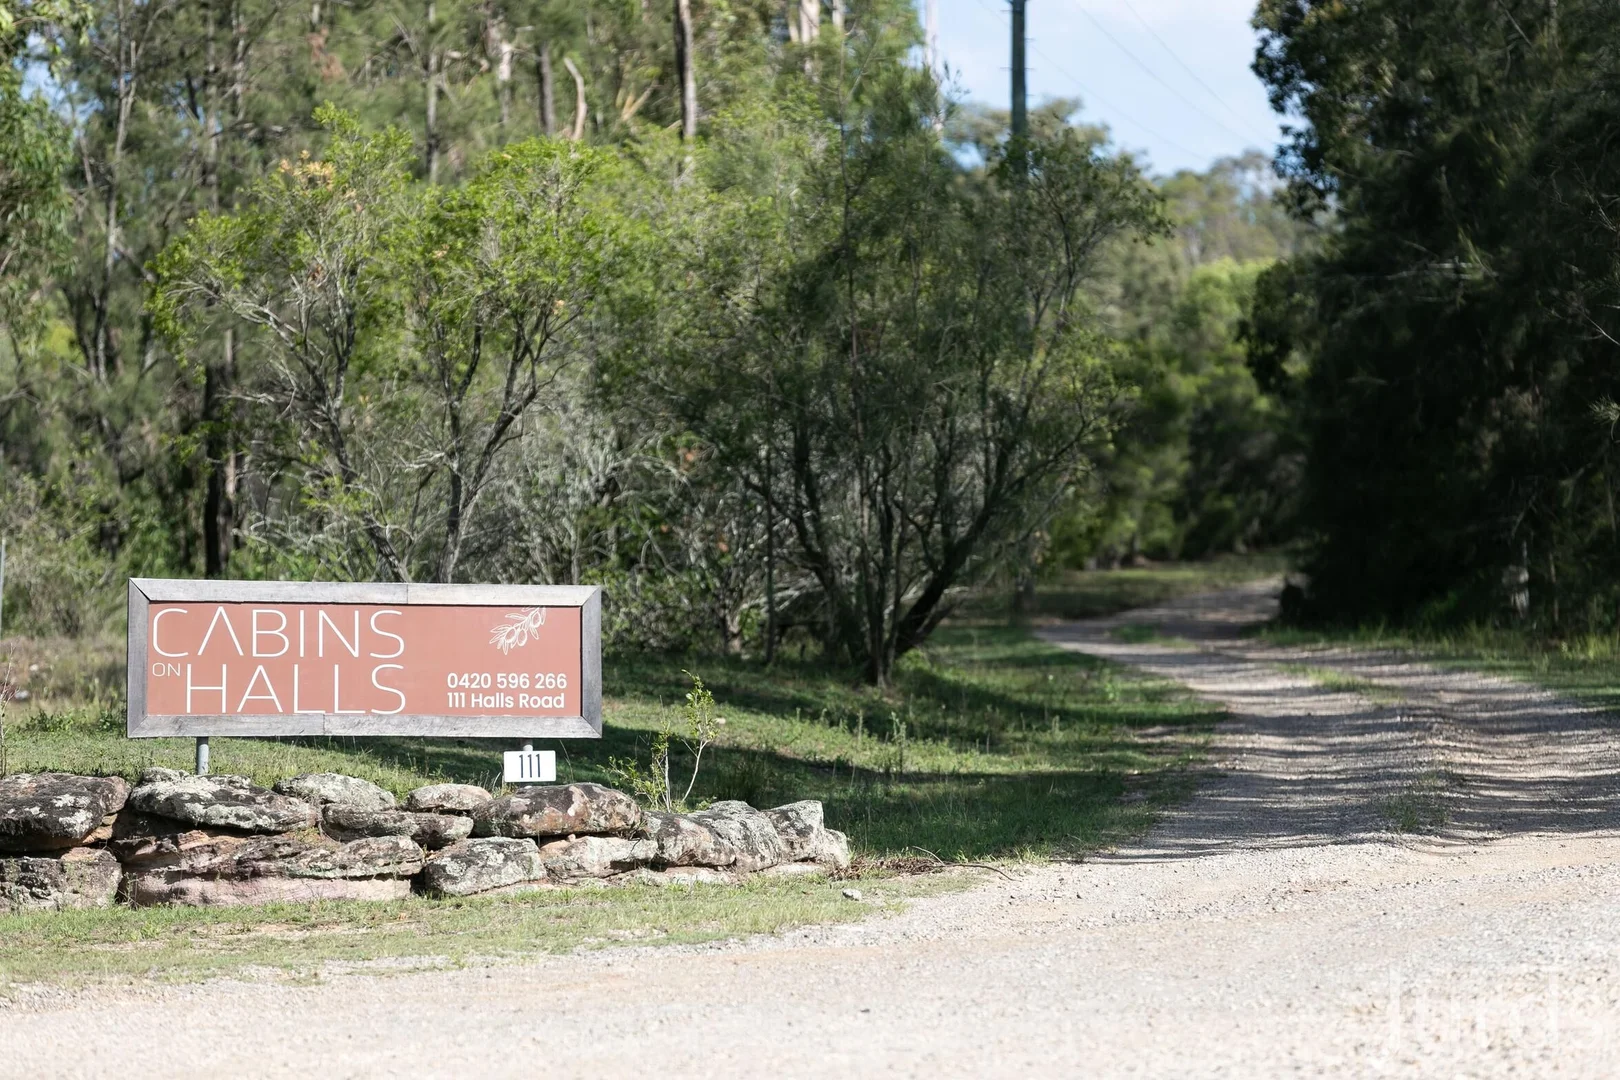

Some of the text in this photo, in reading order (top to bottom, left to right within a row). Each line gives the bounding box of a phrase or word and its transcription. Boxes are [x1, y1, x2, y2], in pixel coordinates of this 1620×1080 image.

[153, 606, 404, 658] CABINS
[153, 663, 405, 714] ON HALLS
[448, 673, 567, 688] 0420 596 266
[448, 693, 564, 708] 111 Halls Road
[519, 754, 540, 778] 111
